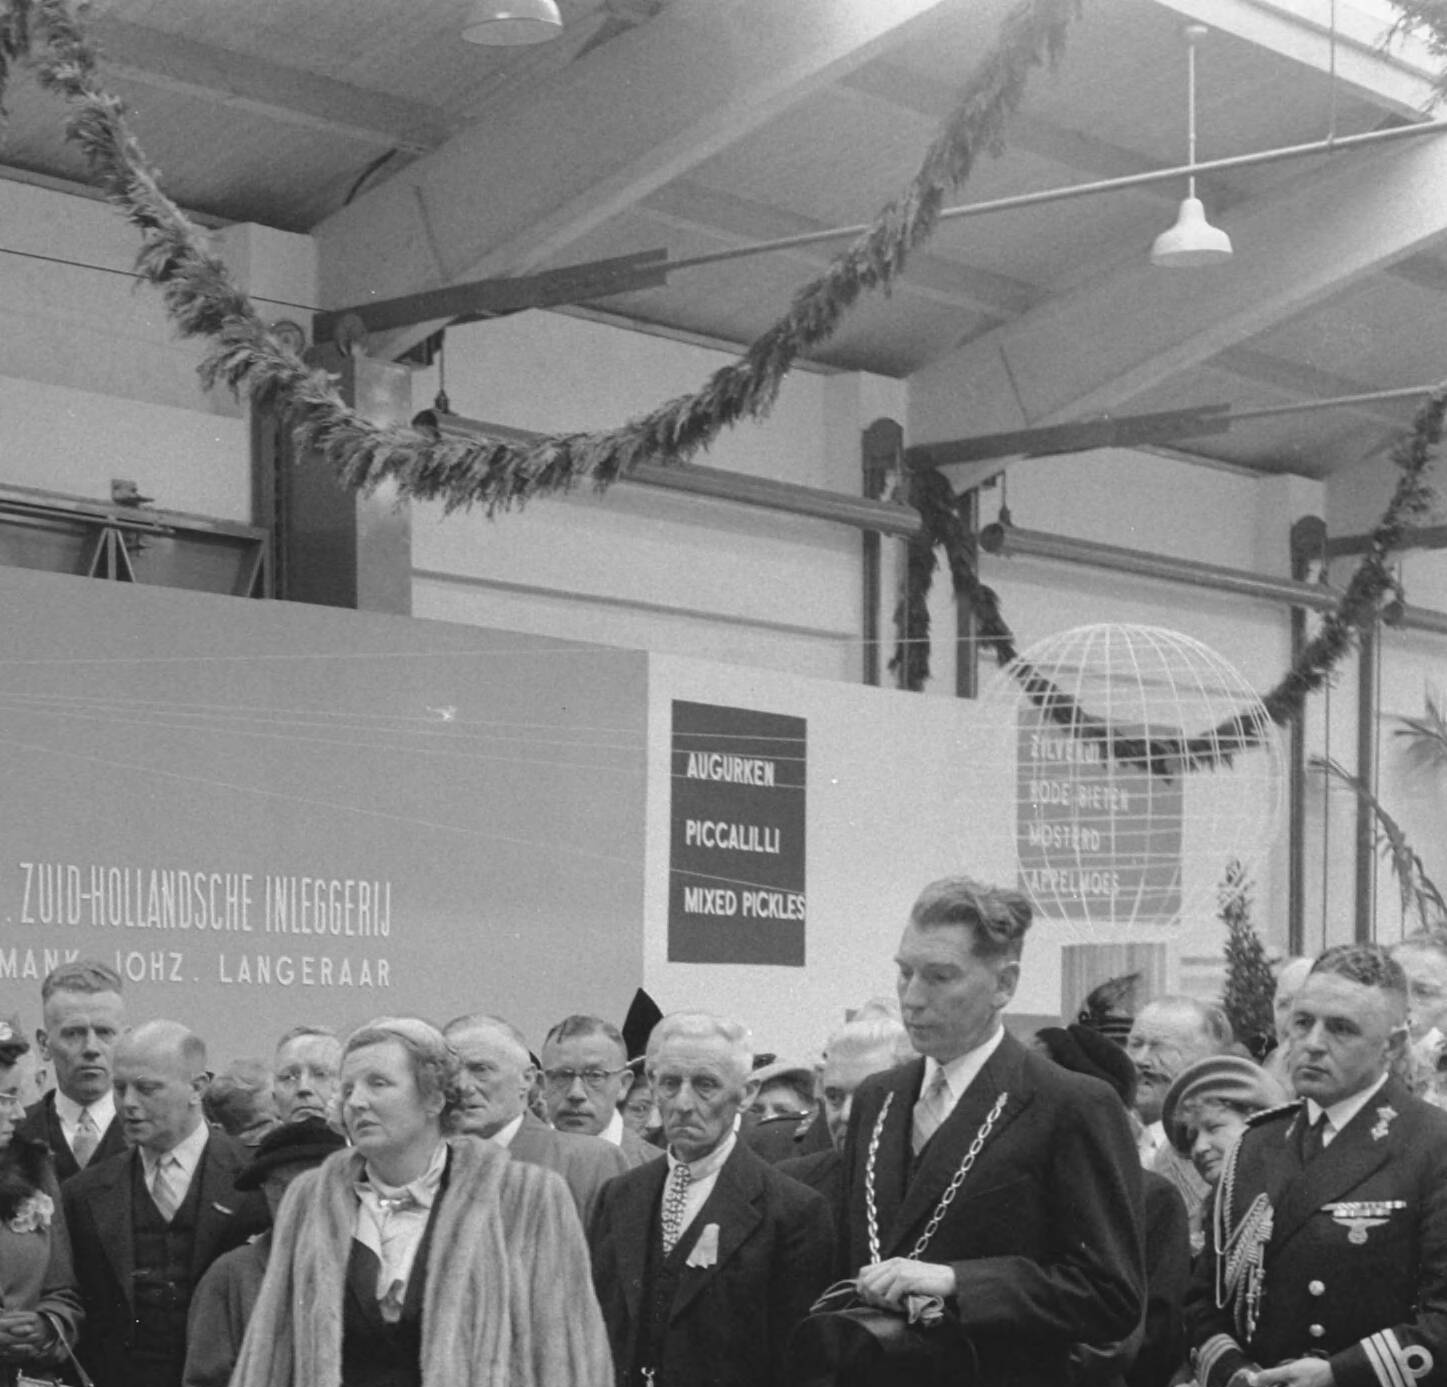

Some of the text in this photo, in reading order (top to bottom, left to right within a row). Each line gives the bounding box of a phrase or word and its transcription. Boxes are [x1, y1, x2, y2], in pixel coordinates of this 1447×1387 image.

[687, 752, 774, 787] AUGURKEN
[685, 819, 780, 854] PICCALILLI
[20, 862, 253, 932] ZUID-HOLLANDSCHE
[265, 875, 391, 937] INLEGGERIJ
[683, 886, 806, 920] MIXED PICKLES
[219, 953, 390, 987] LANGERAAR
